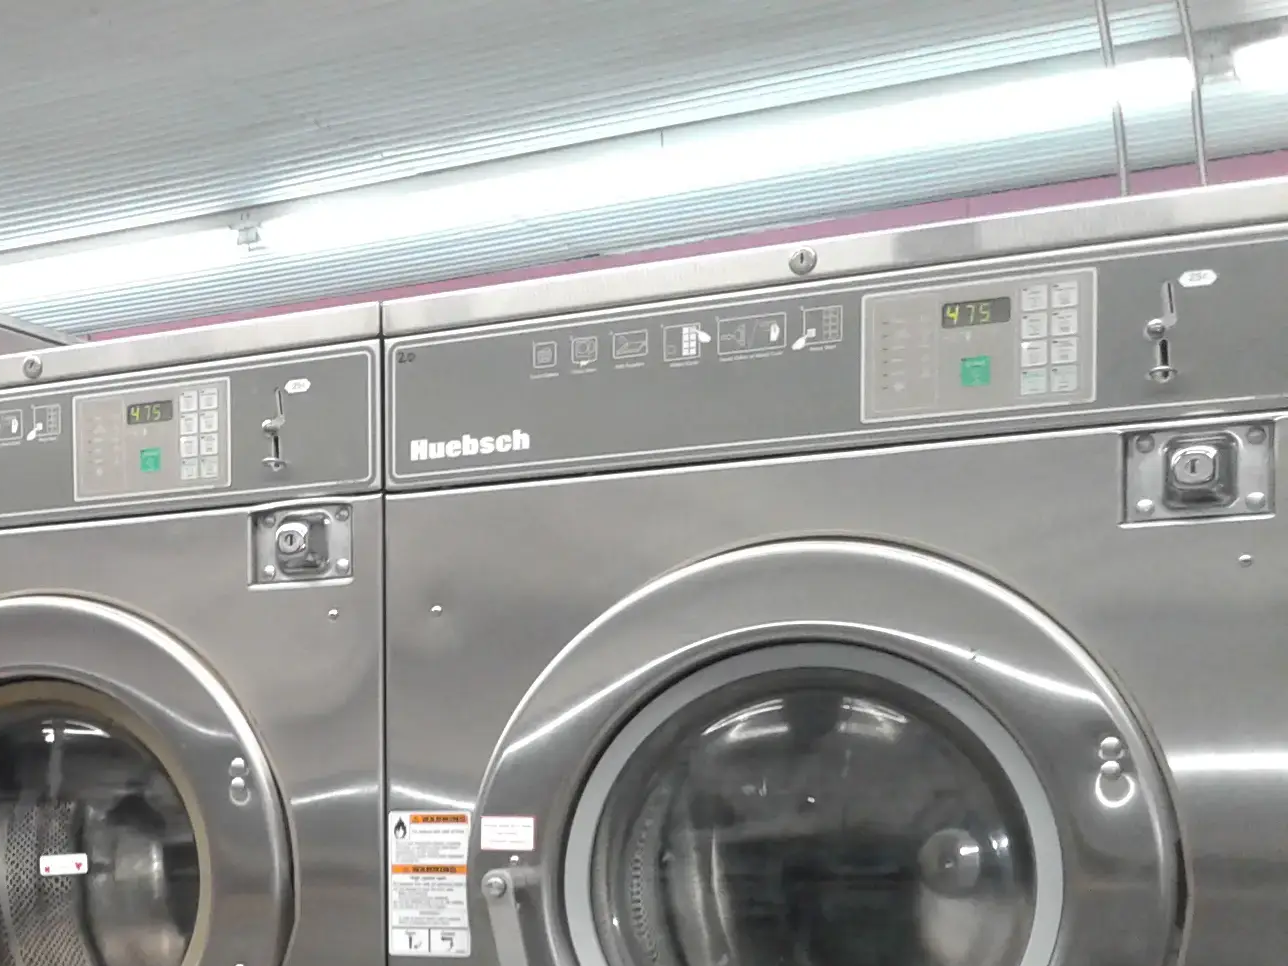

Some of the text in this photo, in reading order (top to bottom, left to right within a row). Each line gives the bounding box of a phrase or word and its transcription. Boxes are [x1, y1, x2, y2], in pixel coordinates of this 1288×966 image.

[945, 303, 991, 325] 475
[129, 404, 162, 421] 475
[410, 429, 531, 461] Huebsch
